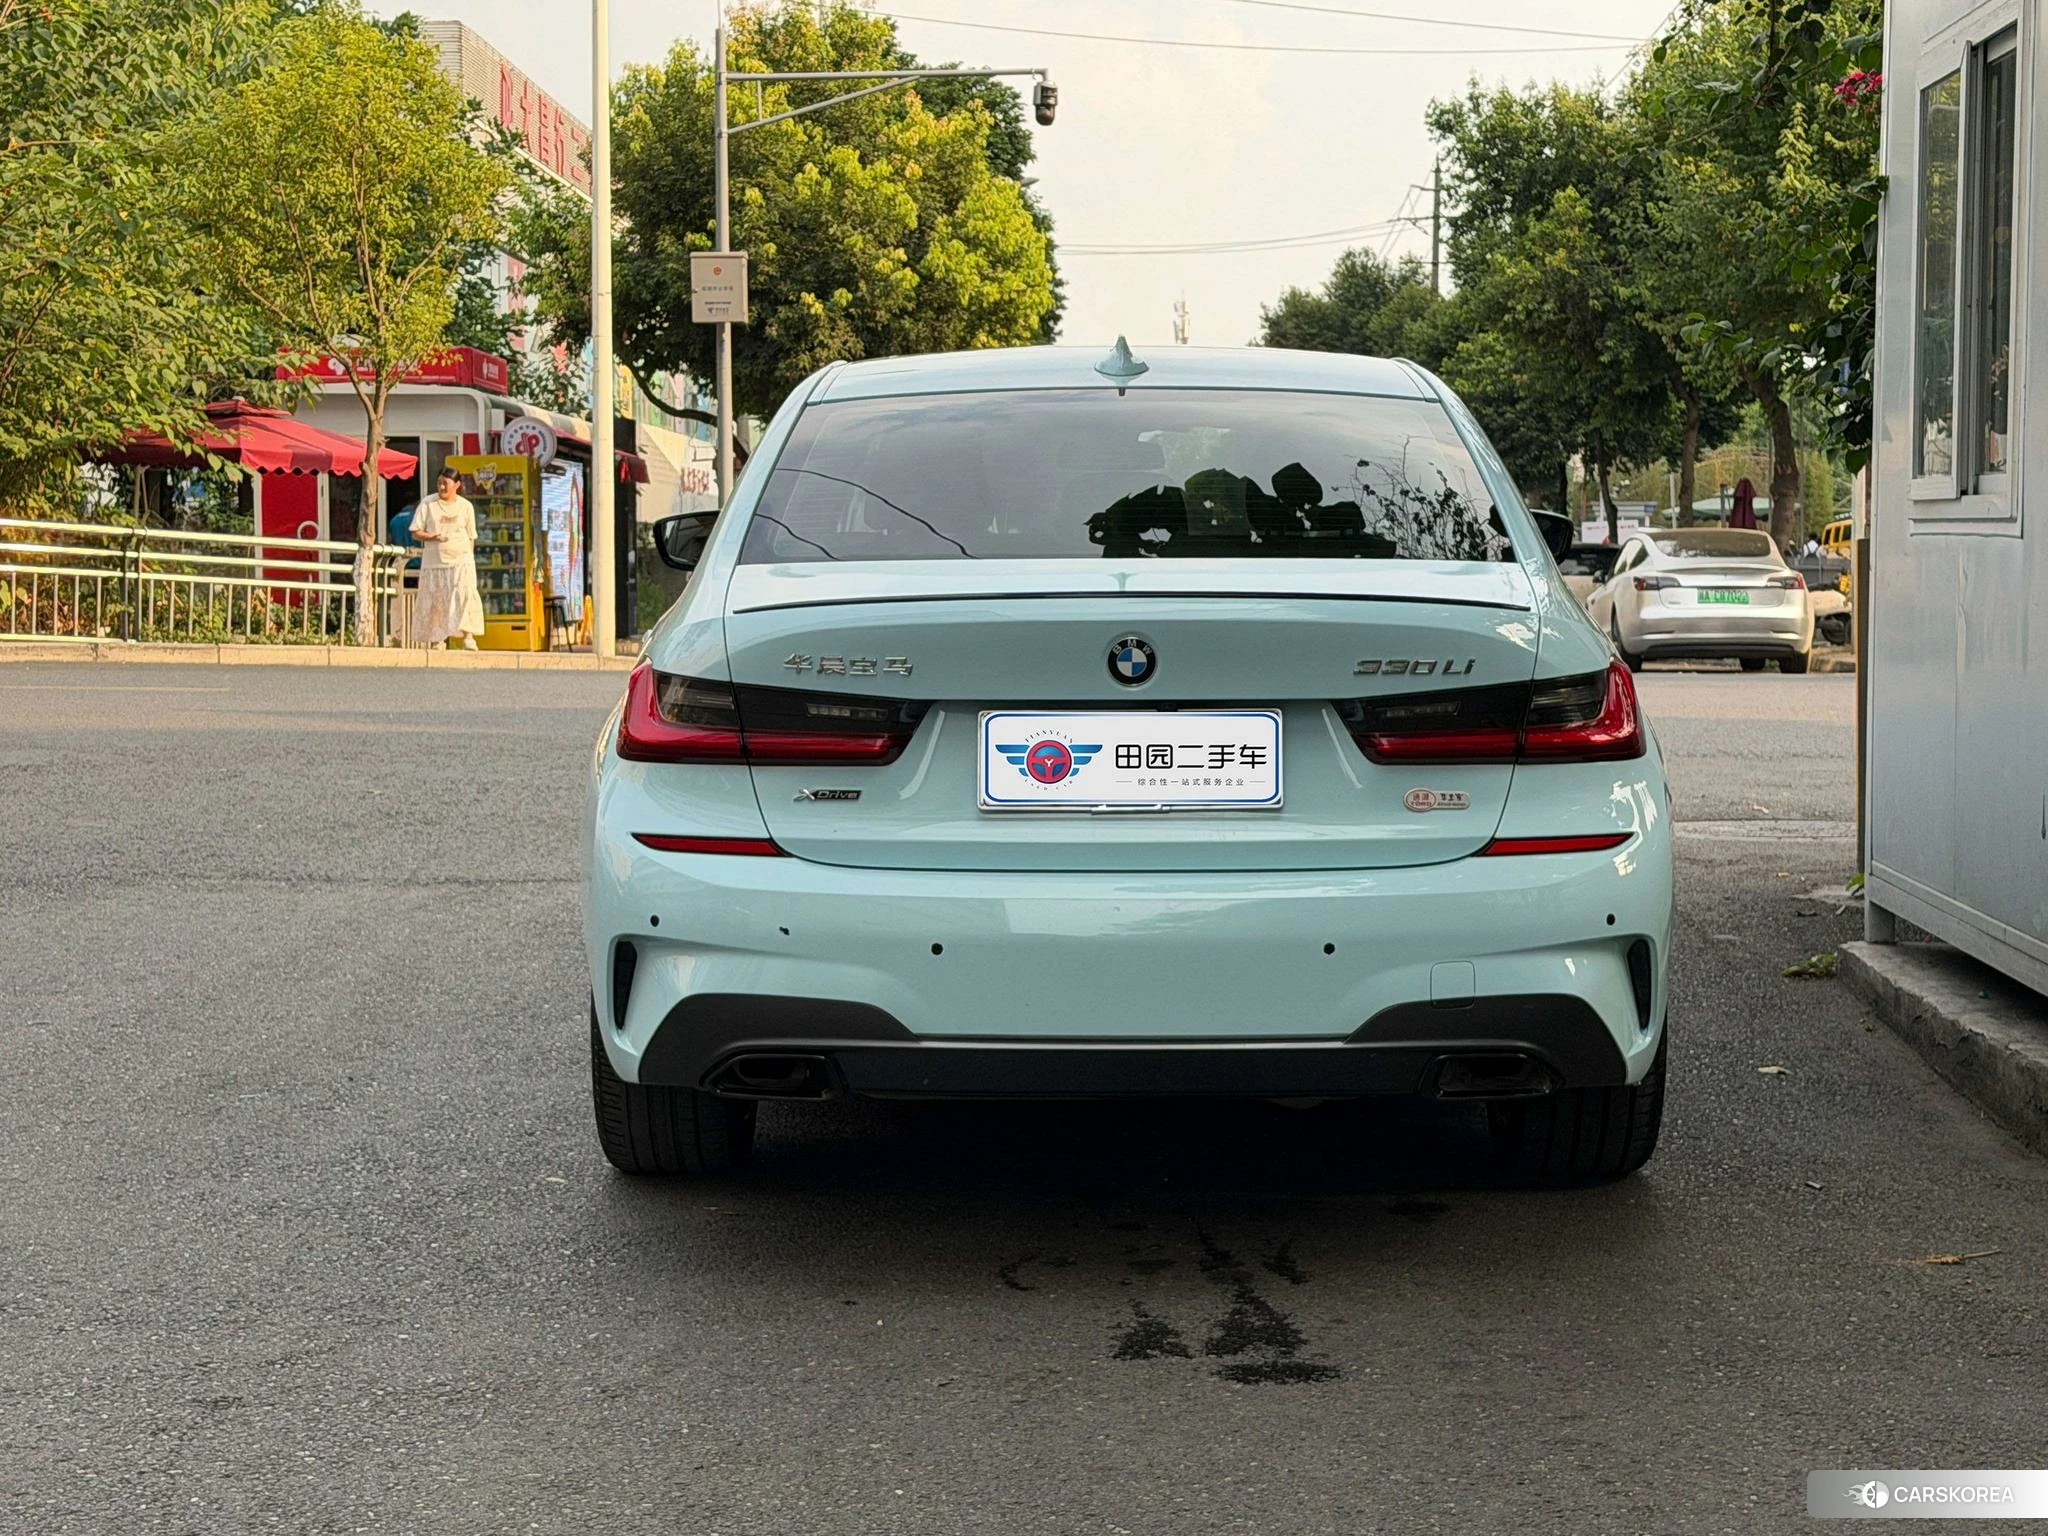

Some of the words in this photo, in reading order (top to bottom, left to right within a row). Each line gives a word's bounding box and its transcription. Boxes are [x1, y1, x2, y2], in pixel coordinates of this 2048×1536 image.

[1112, 639, 1152, 654] BMW
[783, 653, 913, 676] 华晨宝马
[1115, 744, 1267, 769] 田园二手车
[1137, 778, 1244, 786] 综合性一站式服务企业
